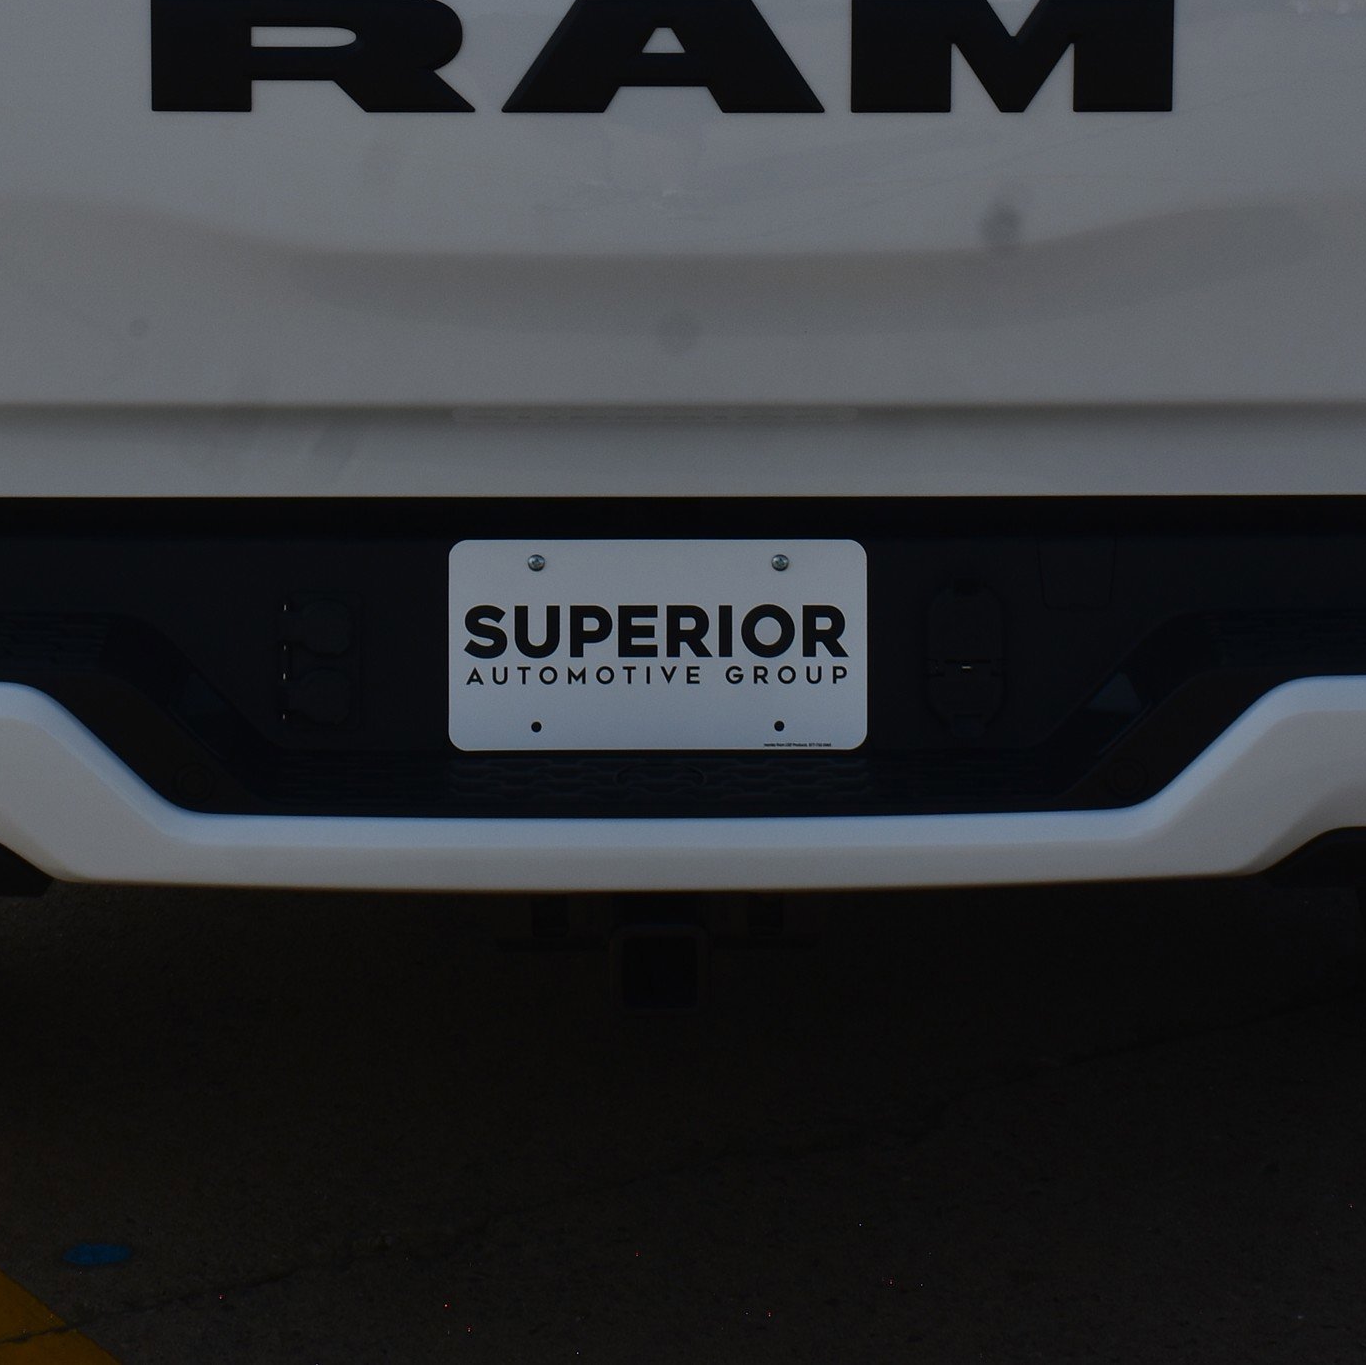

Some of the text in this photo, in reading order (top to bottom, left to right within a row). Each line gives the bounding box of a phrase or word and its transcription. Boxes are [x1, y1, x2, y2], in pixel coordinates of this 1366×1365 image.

[464, 604, 850, 660] SUPERIOR
[466, 666, 849, 686] AUTOMOTIVE GROUP
